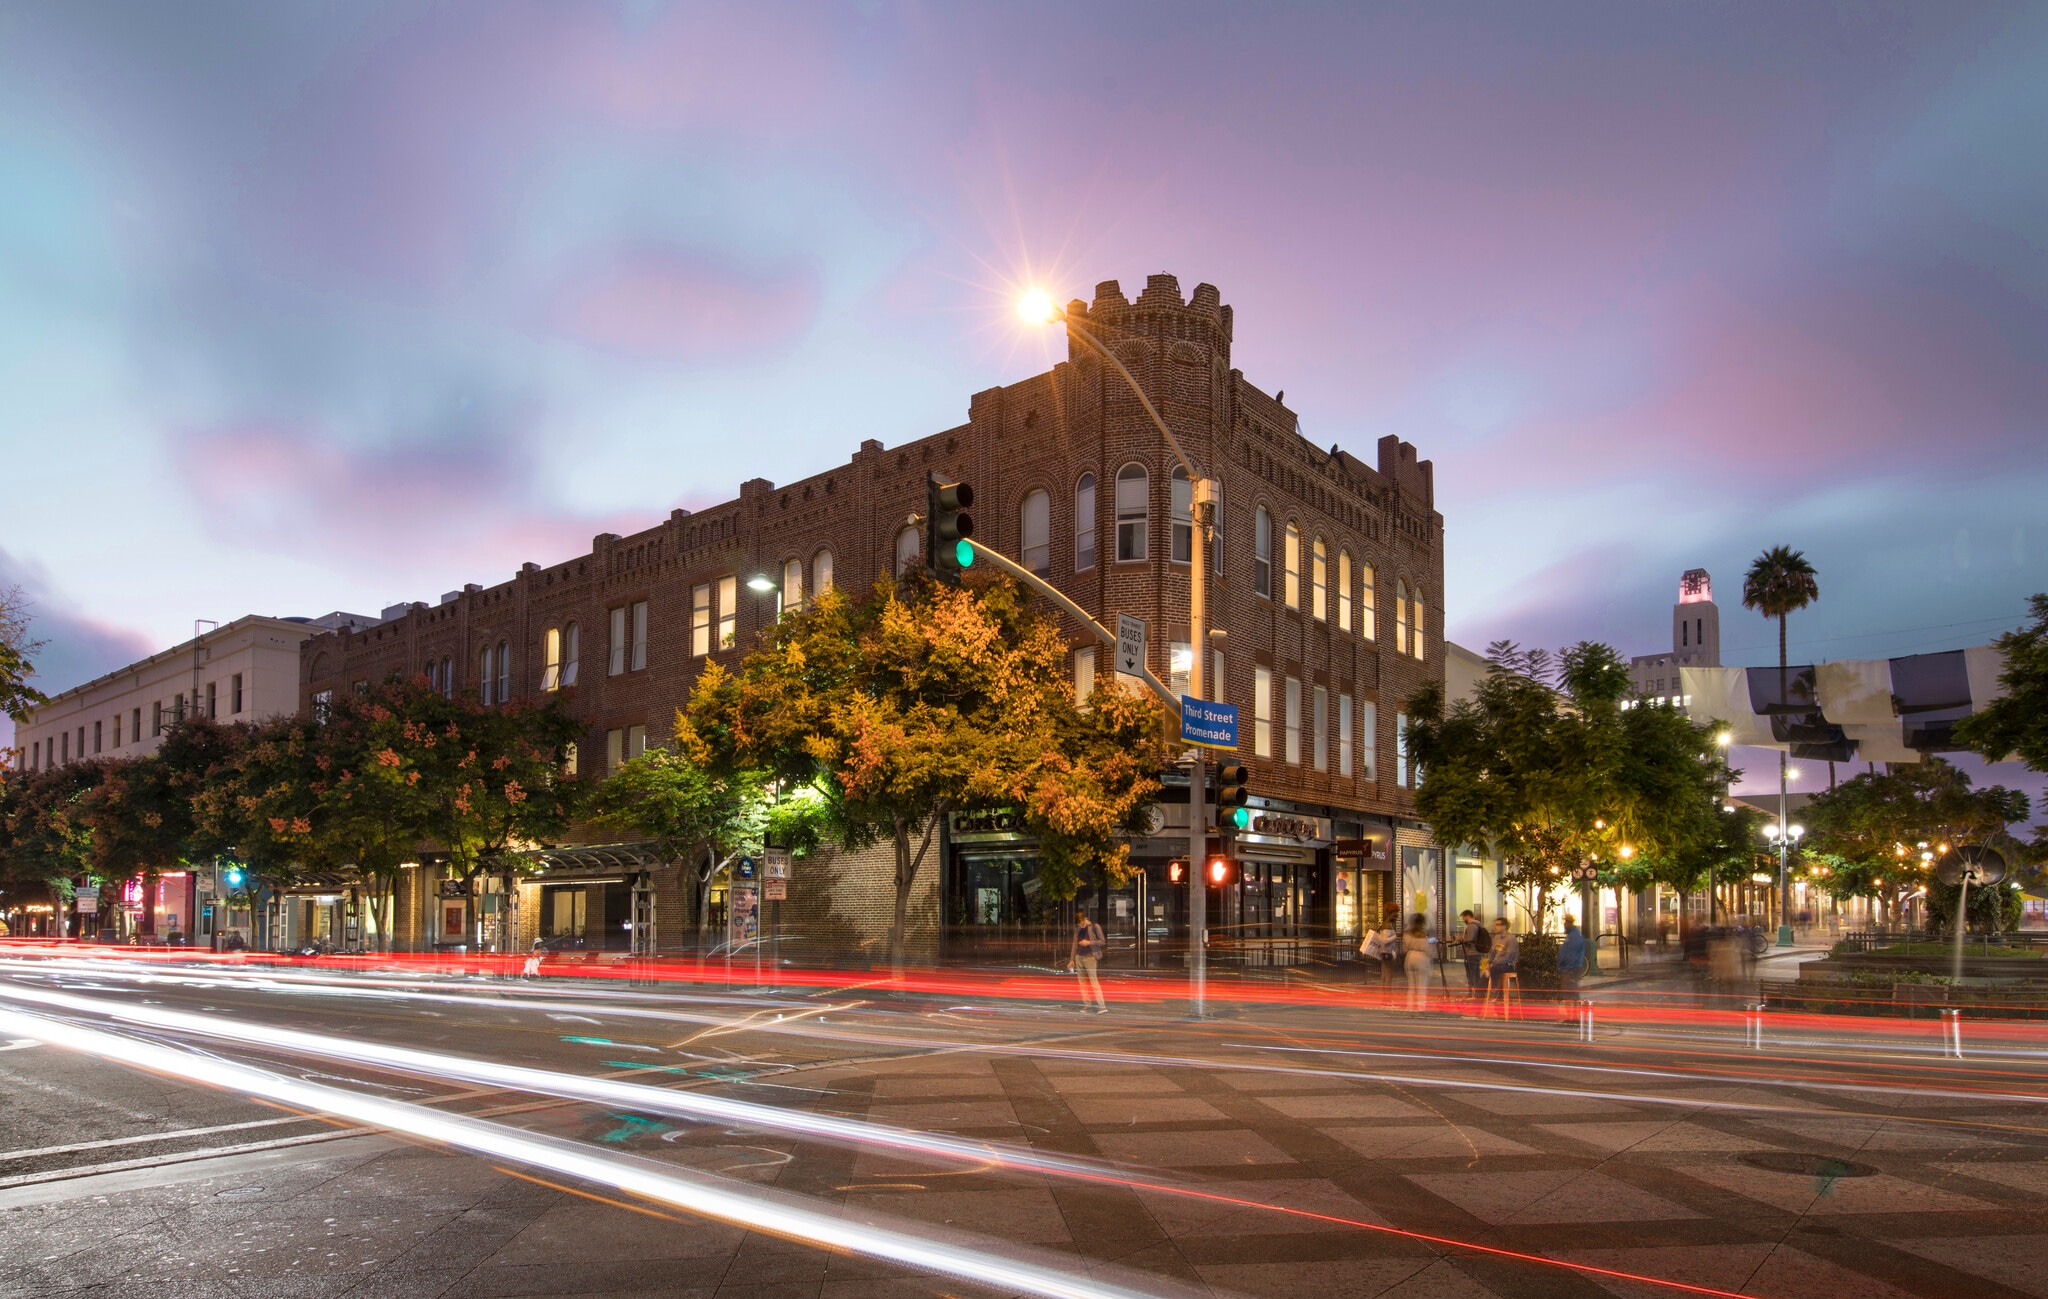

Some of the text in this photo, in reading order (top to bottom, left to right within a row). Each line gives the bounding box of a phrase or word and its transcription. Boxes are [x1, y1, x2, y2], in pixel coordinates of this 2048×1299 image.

[1120, 626, 1142, 643] BUSES
[1122, 641, 1139, 656] ONLY
[1184, 704, 1233, 724] Third Street
[1185, 722, 1231, 741] Promenade
[767, 856, 789, 866] BUSES
[1371, 850, 1386, 860] PYRUS
[770, 866, 786, 875] ONLY
